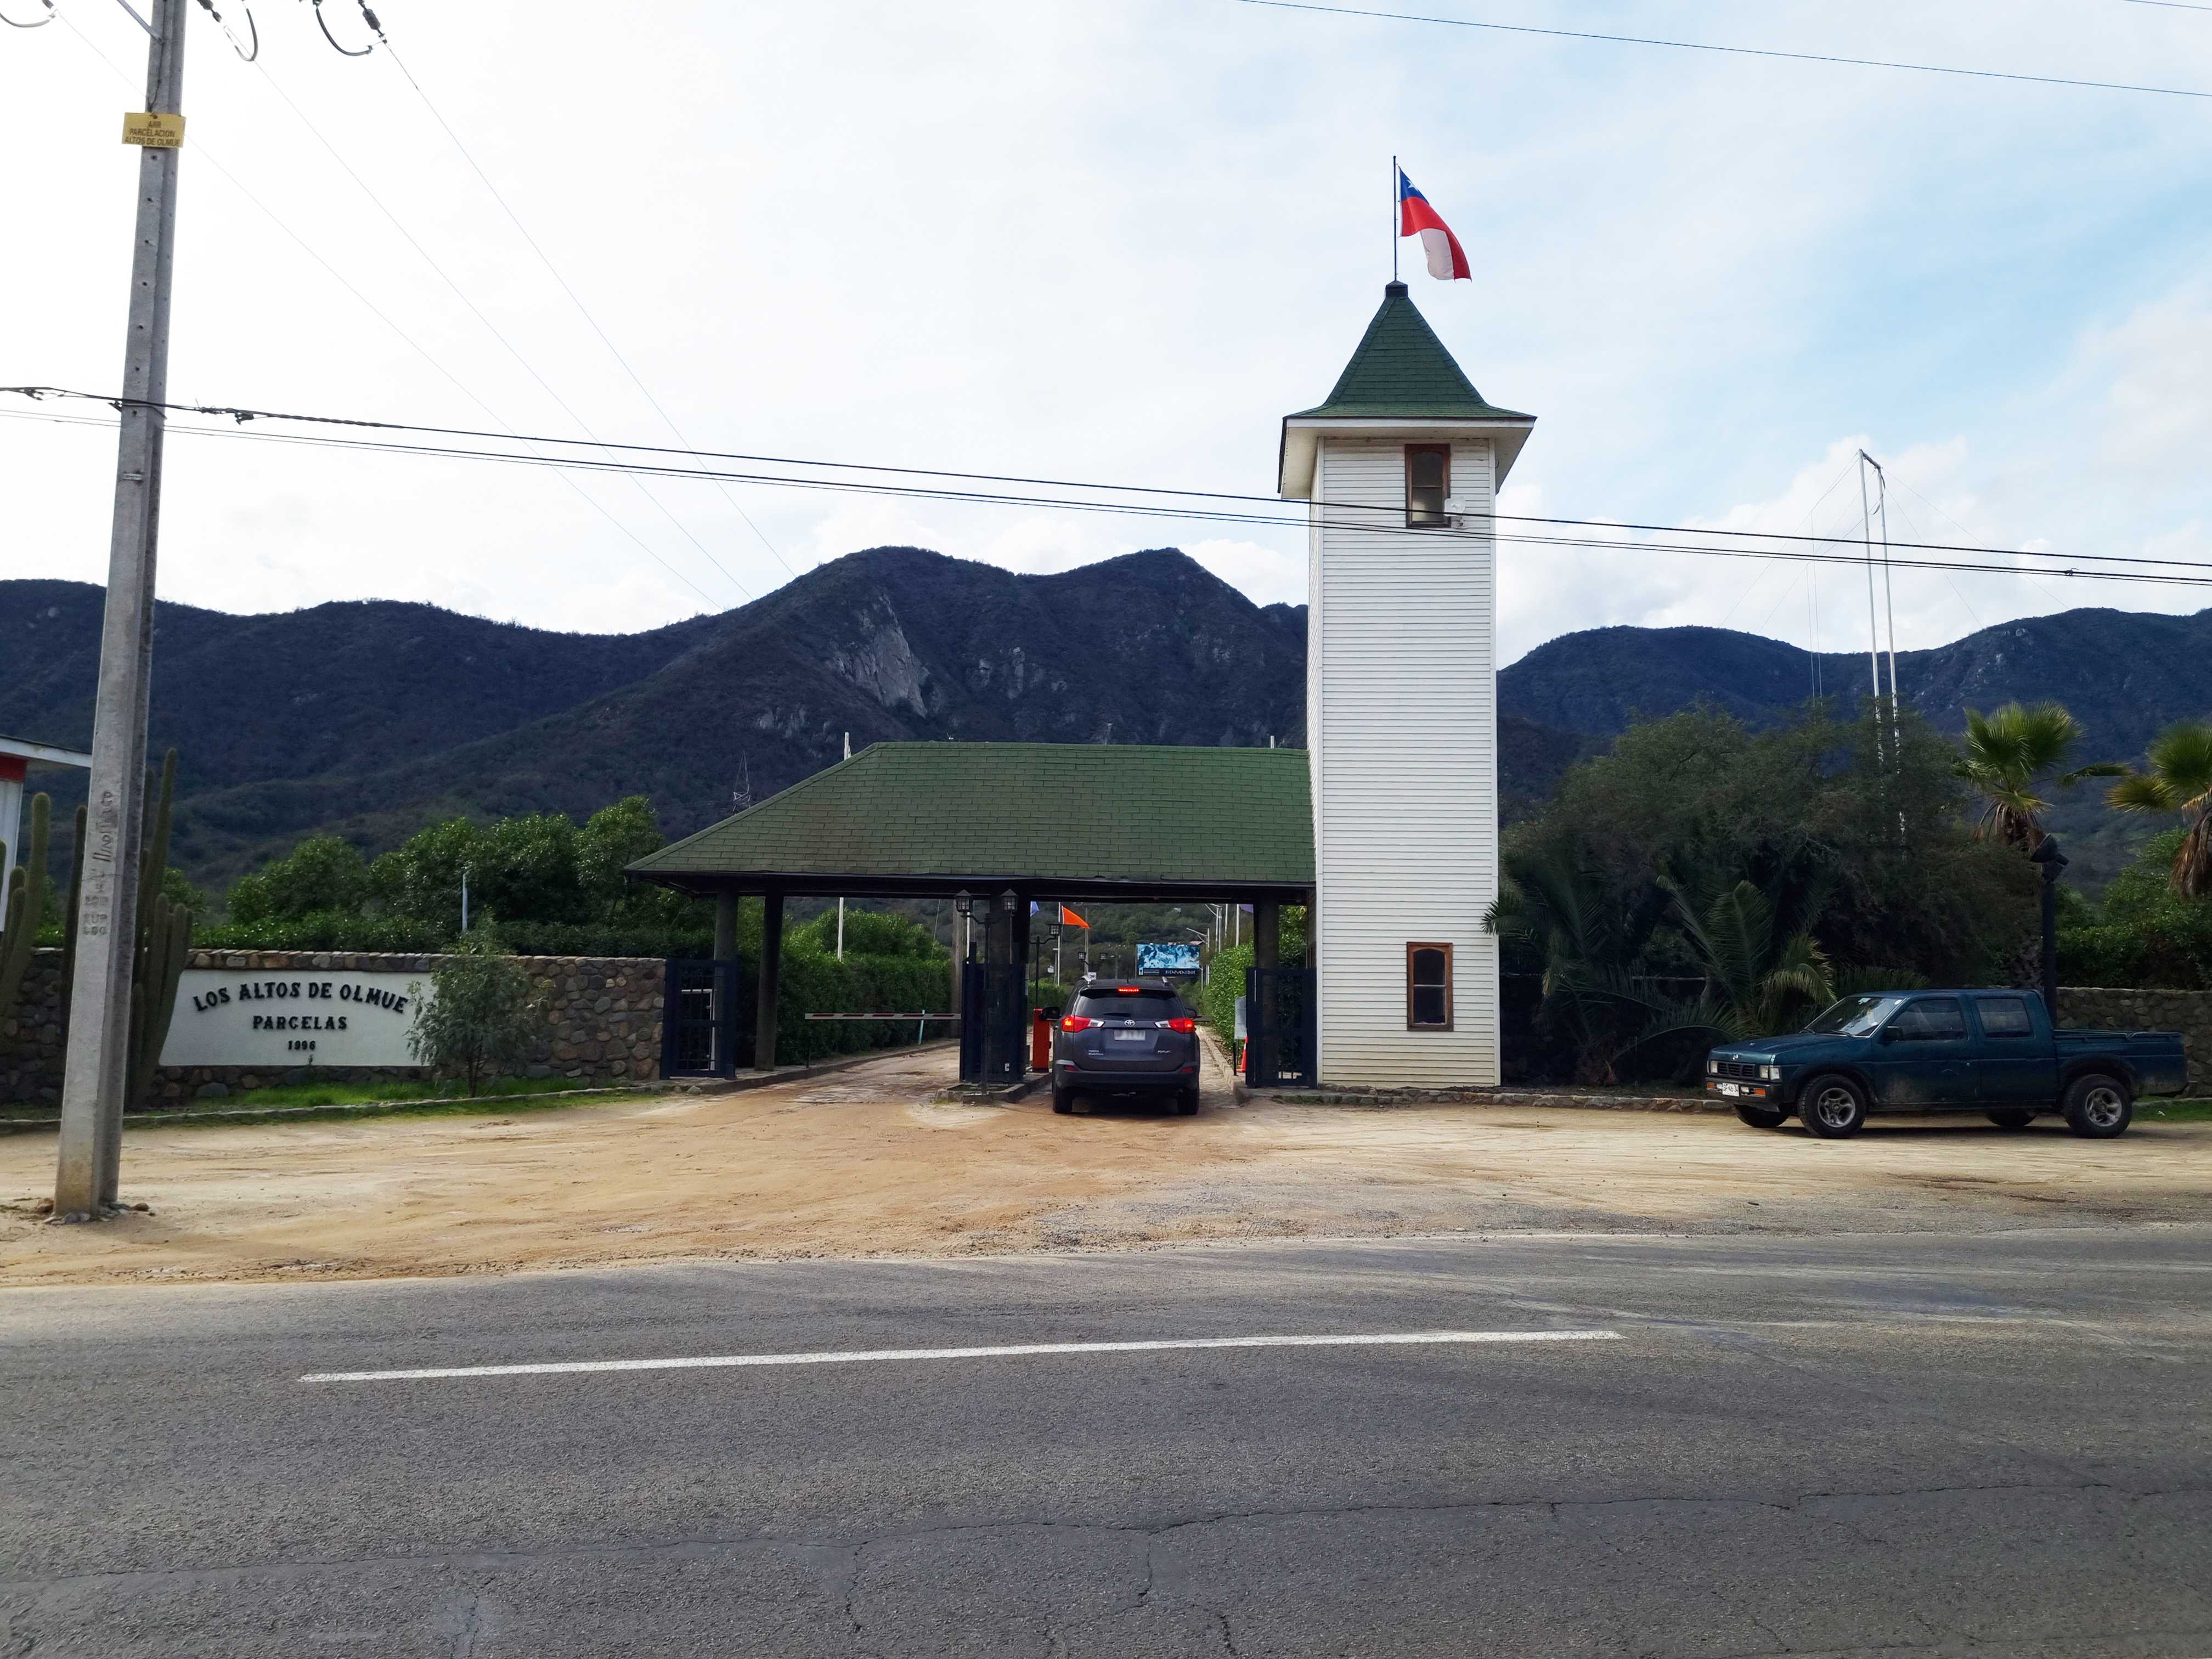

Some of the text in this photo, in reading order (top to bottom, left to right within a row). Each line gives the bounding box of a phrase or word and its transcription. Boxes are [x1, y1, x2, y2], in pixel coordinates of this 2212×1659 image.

[193, 982, 409, 1014] LOS ALTOS DE OLMUE
[253, 1015, 347, 1030] PARCELAS
[287, 1040, 316, 1050] 1996
